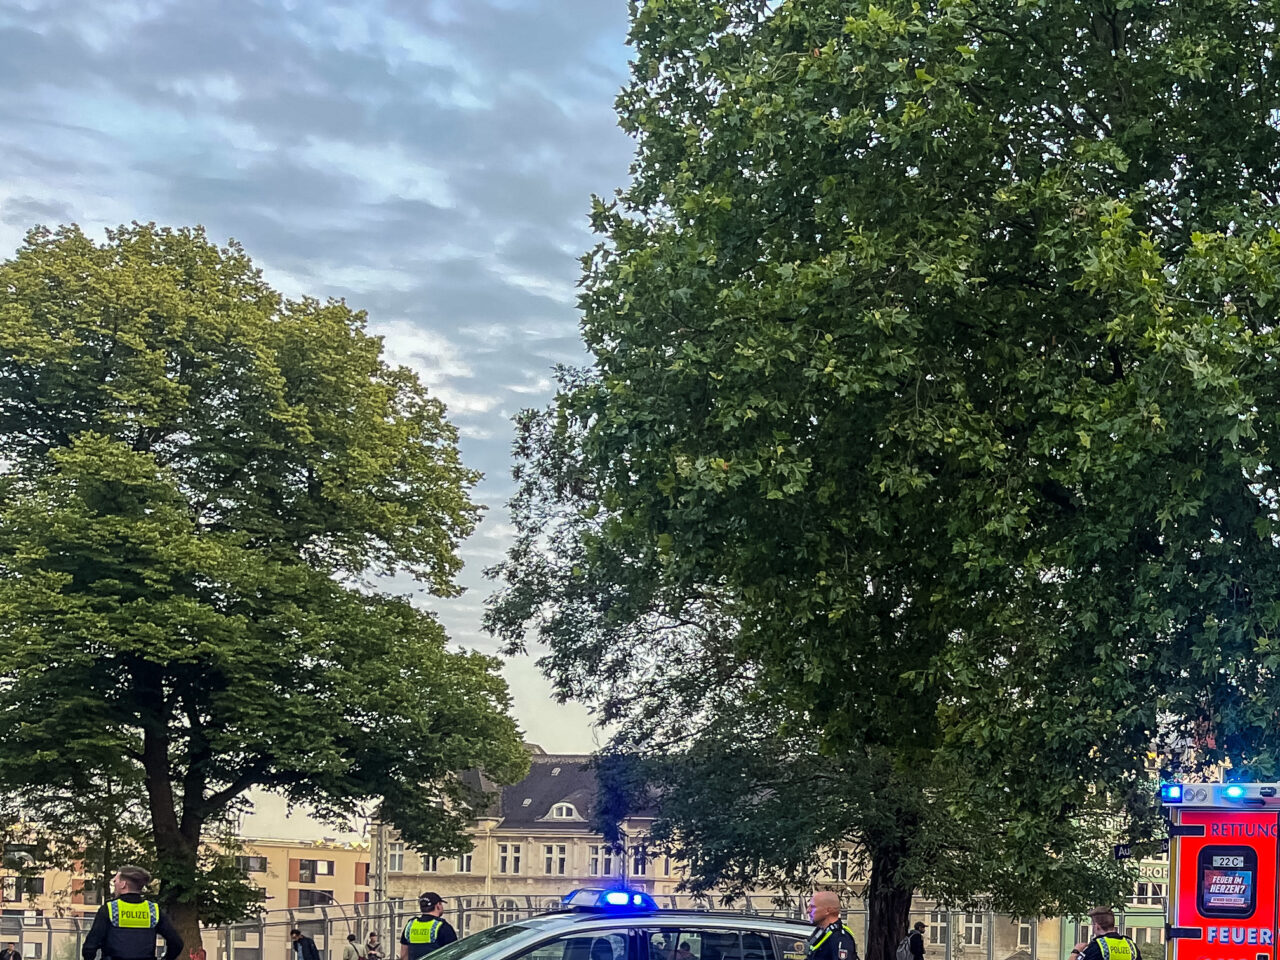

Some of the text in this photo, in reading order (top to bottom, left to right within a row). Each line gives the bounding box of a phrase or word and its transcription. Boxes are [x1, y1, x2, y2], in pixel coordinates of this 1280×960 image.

[1212, 876, 1243, 885] FEUER IM
[1209, 884, 1245, 894] HERZEN?
[121, 910, 149, 920] POLIZEI
[1110, 945, 1131, 955] POLIZEI
